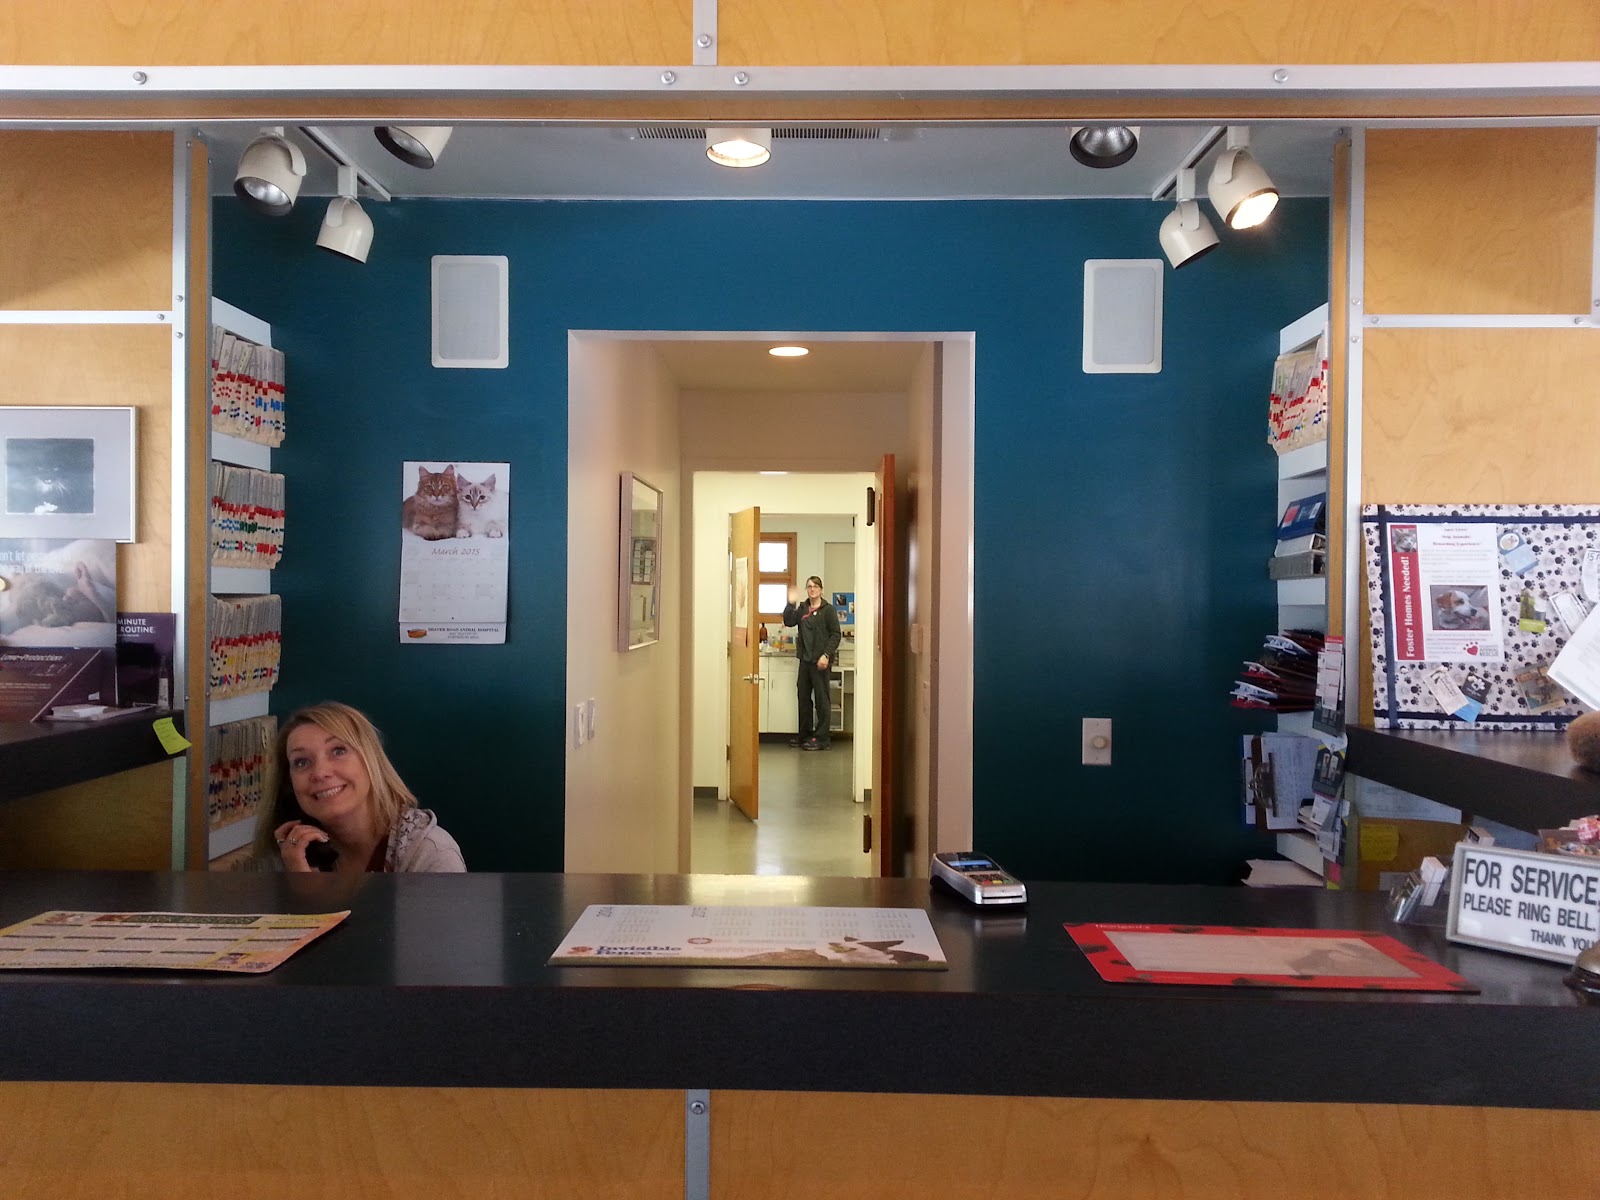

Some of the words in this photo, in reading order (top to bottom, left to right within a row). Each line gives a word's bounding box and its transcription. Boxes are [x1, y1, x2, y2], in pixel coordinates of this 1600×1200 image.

[432, 547, 458, 555] March
[461, 548, 480, 556] 2015
[1401, 556, 1411, 592] Needed!
[117, 618, 146, 626] MINUTE
[1405, 595, 1413, 625] Homes
[1406, 628, 1415, 657] Foster
[1464, 858, 1502, 889] FOR
[1463, 892, 1512, 917] PLEASE
[1517, 901, 1551, 924] RING
[1557, 907, 1596, 932] BELL.
[1530, 929, 1566, 948] THANK
